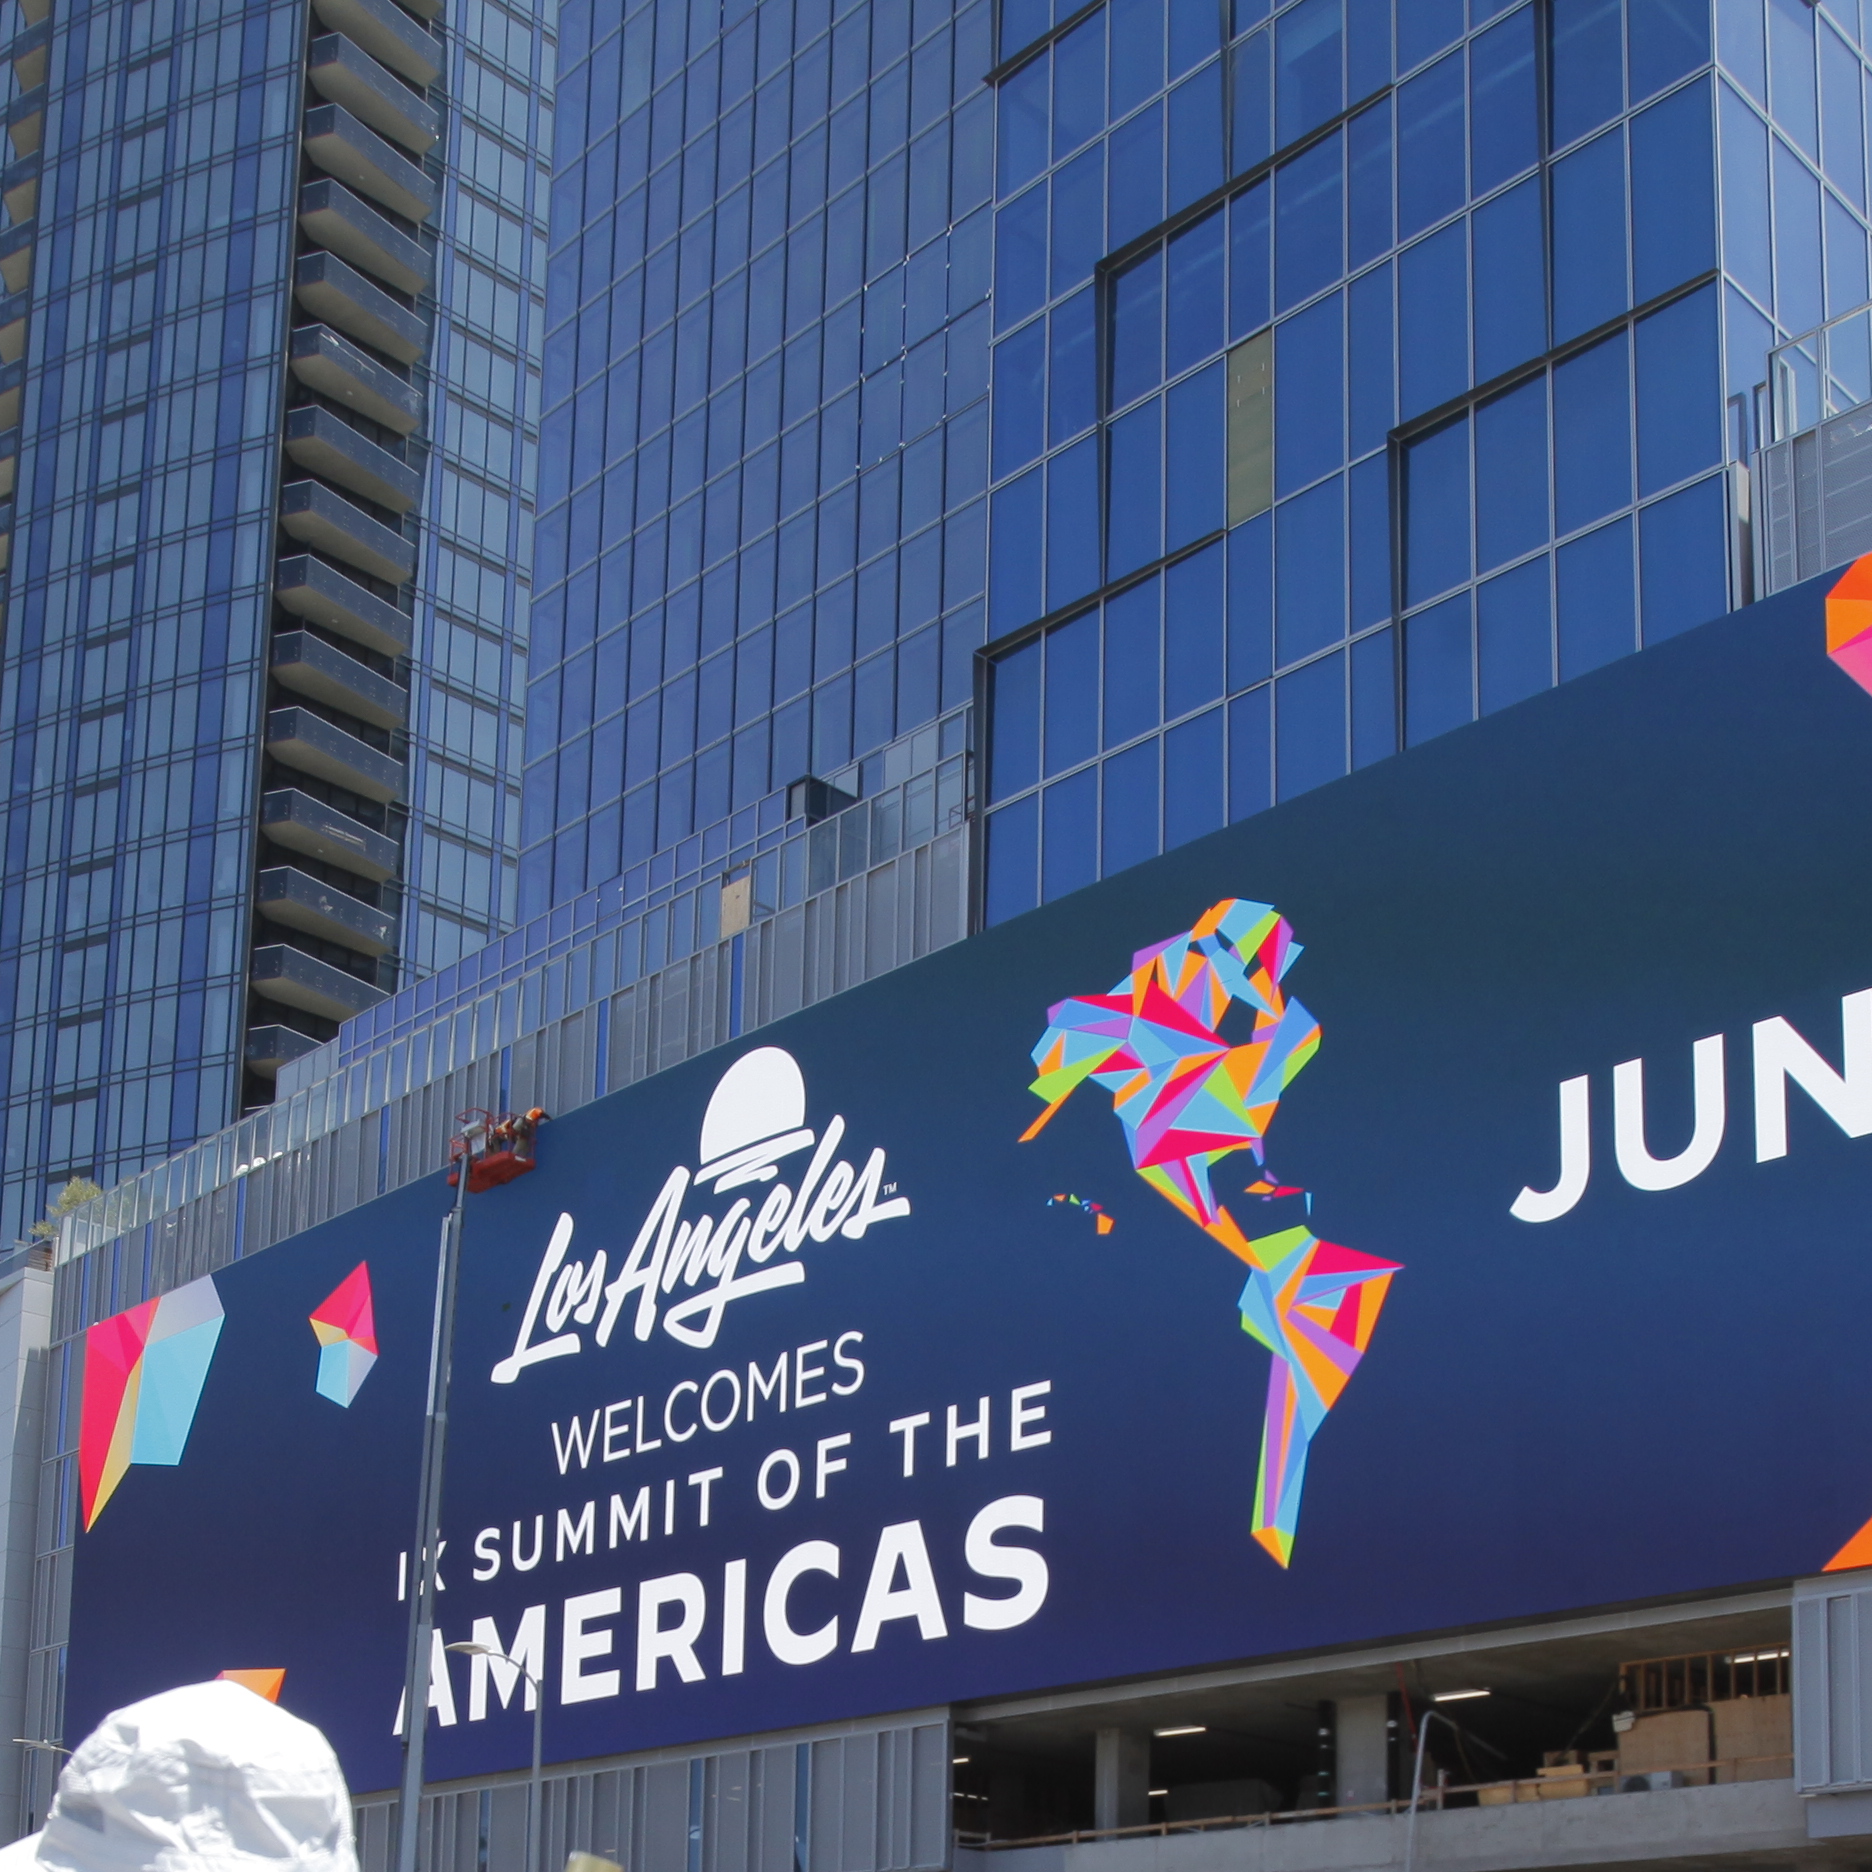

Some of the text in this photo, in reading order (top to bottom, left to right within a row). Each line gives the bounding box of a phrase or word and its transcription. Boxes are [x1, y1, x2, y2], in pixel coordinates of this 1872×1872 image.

[491, 1211, 602, 1385] Los
[595, 1113, 910, 1348] Angeles
[472, 1468, 724, 1583] SUMMIT
[757, 1431, 849, 1511] OF
[888, 1381, 1052, 1478] THE
[551, 1330, 864, 1476] WELCOMES
[391, 1495, 1050, 1736] AMERICAS
